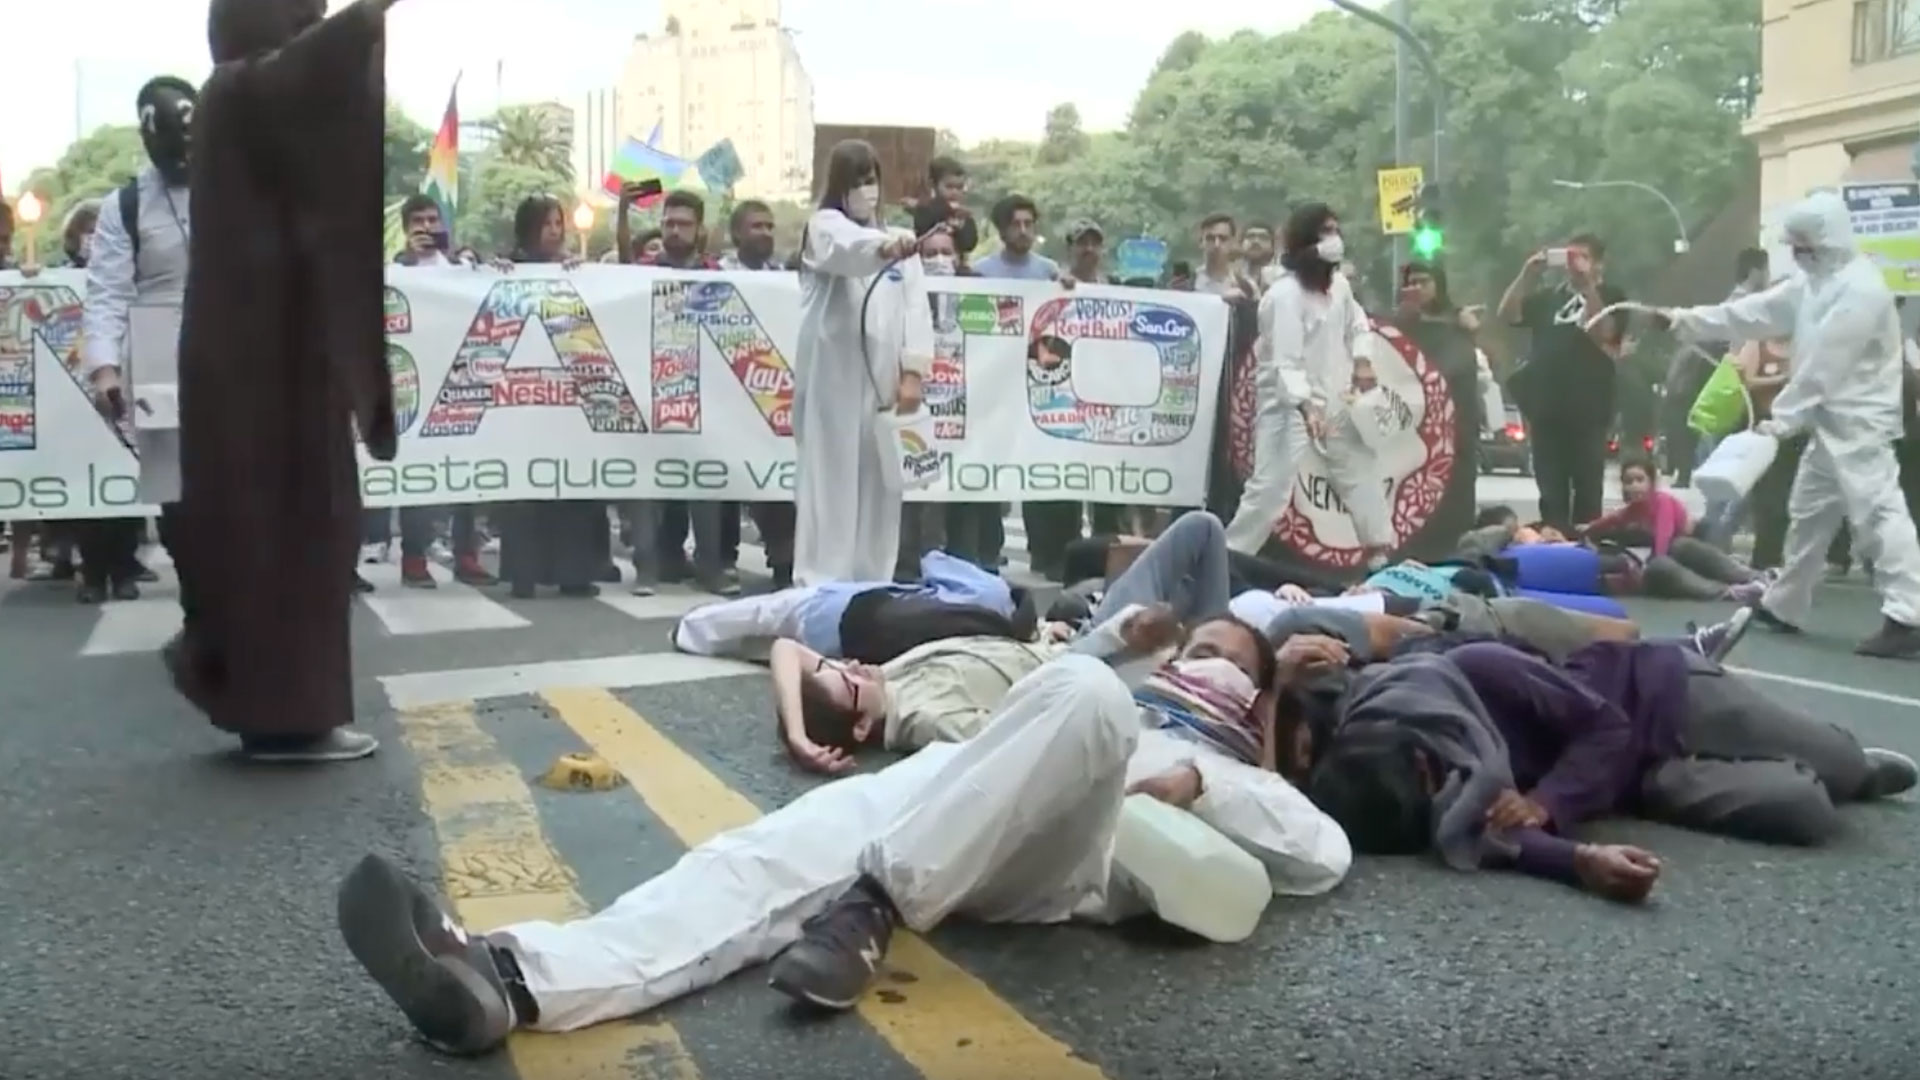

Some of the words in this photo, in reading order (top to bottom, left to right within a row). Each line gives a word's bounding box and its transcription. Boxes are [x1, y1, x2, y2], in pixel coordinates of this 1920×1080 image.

[674, 313, 753, 326] PEPSICO
[440, 387, 493, 402] QUAKER
[527, 456, 636, 498] que
[653, 457, 729, 489] se
